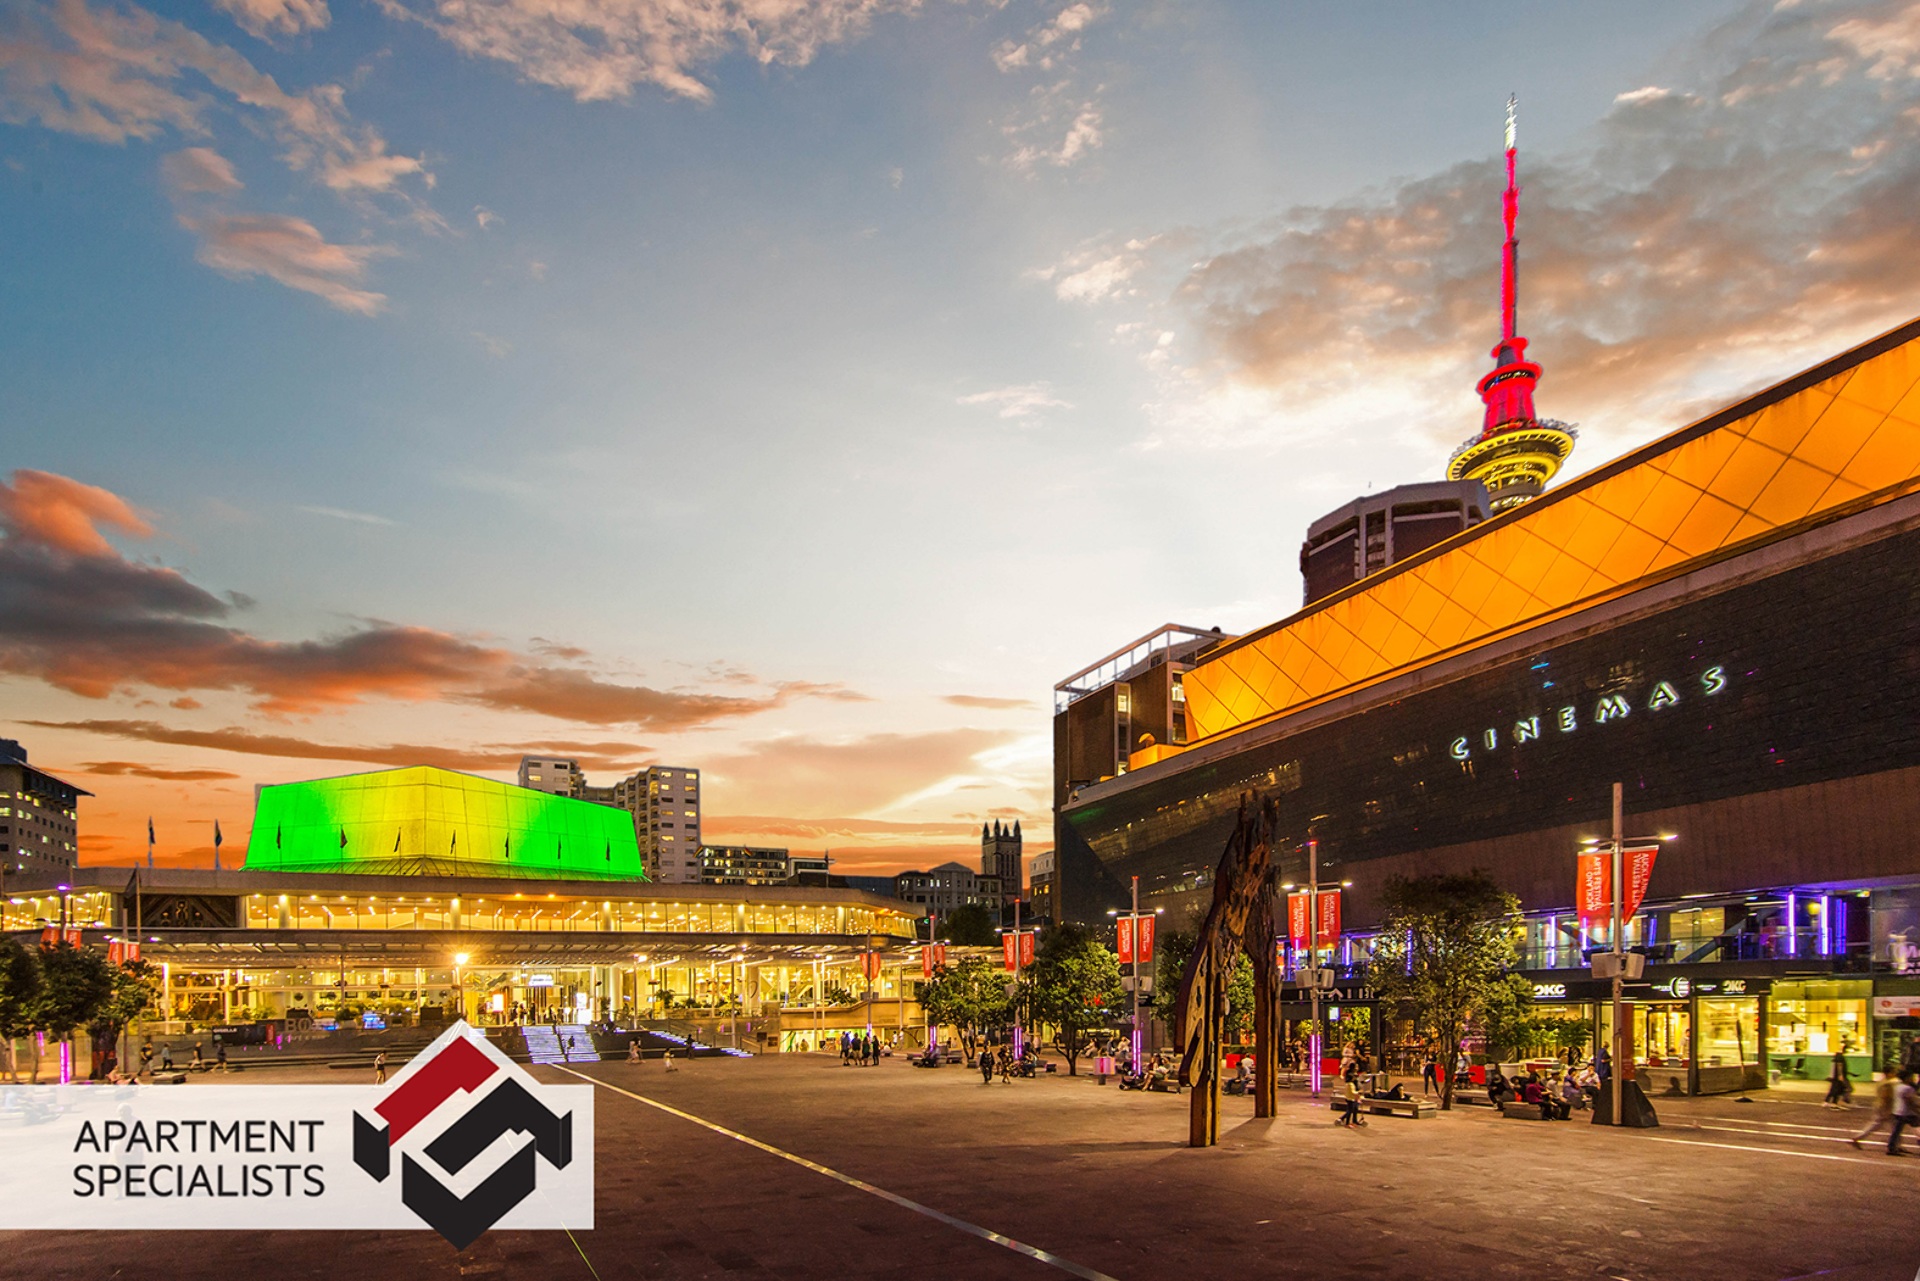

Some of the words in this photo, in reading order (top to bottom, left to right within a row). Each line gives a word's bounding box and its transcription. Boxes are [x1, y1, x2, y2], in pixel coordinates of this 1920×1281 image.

[1449, 665, 1727, 760] CINEMAS
[1632, 853, 1641, 888] FESTIVAL
[1586, 871, 1594, 911] AUCKLAND
[1594, 877, 1602, 911] FESTIVAL
